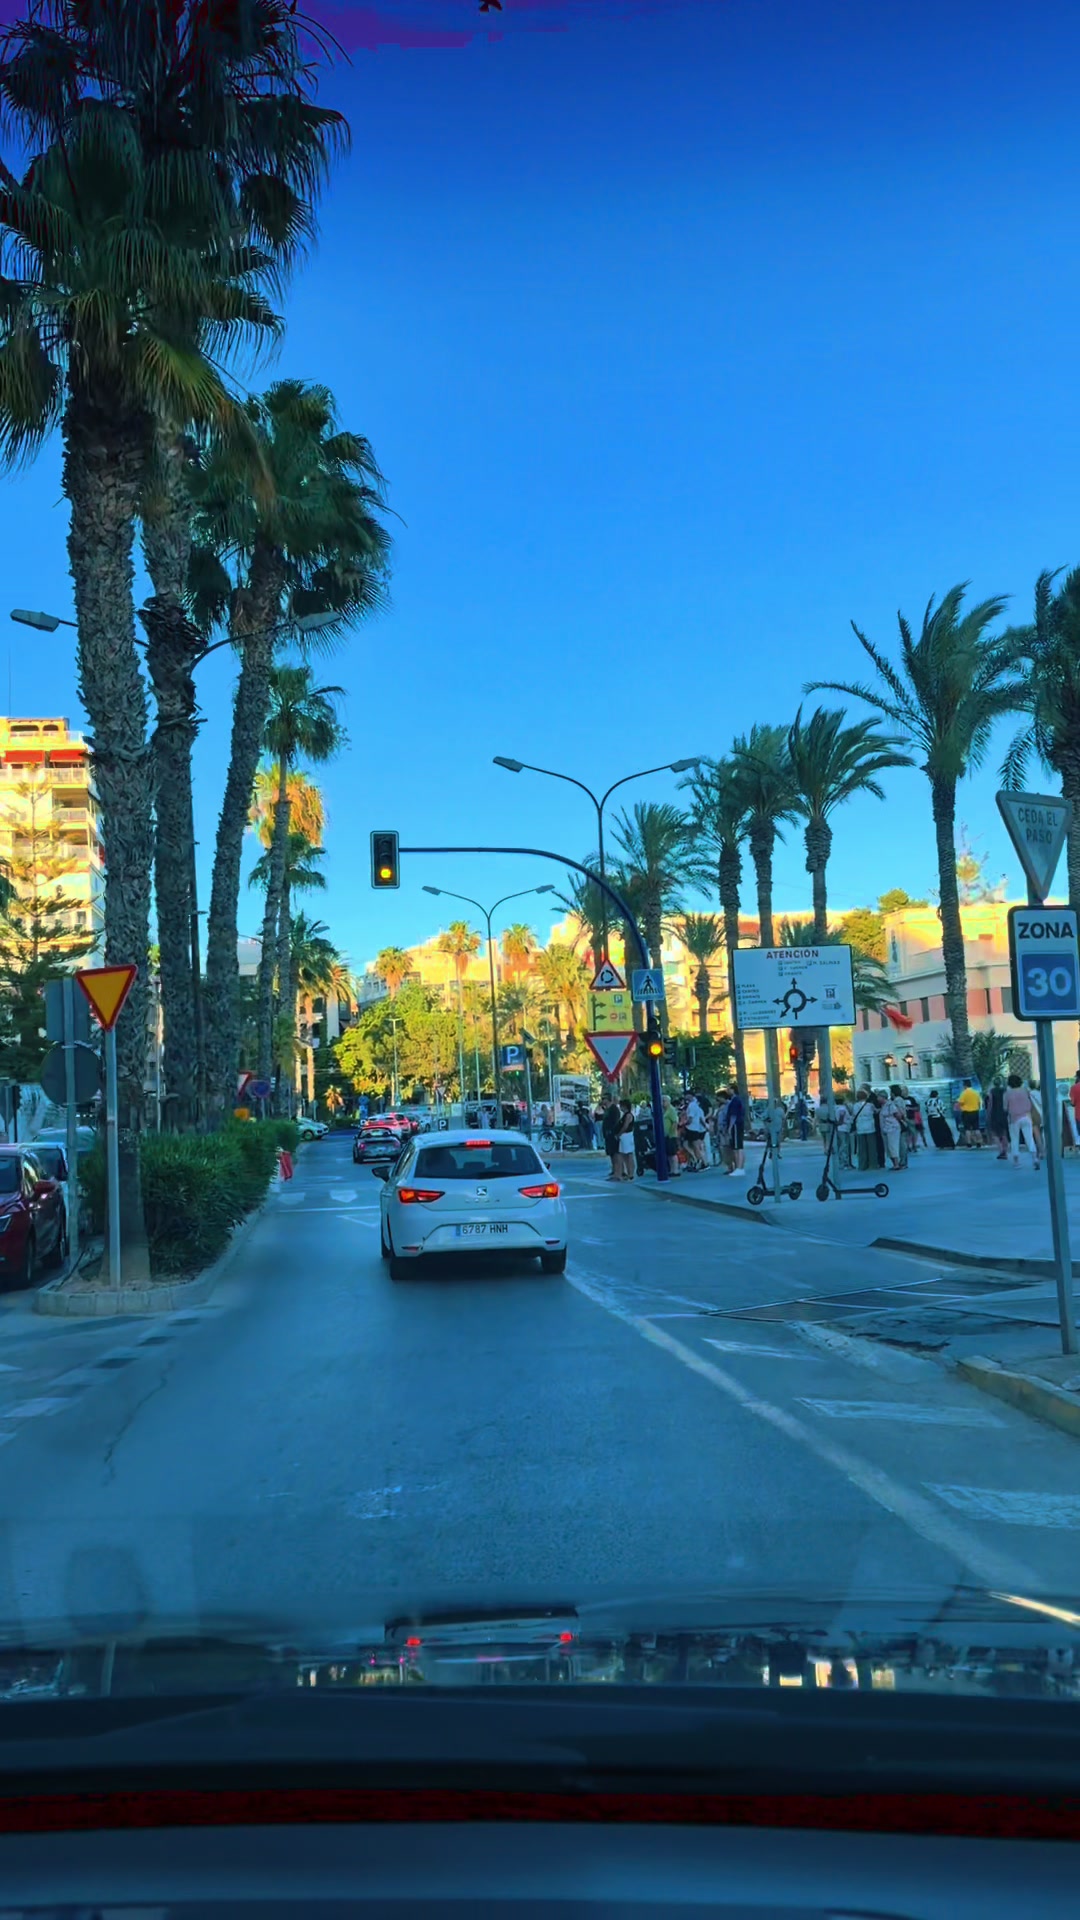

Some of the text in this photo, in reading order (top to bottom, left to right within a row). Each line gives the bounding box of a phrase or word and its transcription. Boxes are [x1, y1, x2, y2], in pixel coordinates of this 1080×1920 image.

[1018, 807, 1059, 827] CEDA EL
[1026, 828, 1053, 845] PASO
[1017, 921, 1075, 939] ZONA
[1026, 967, 1072, 997] 30
[506, 1046, 519, 1064] P
[462, 1224, 508, 1234] 6787 HNH
